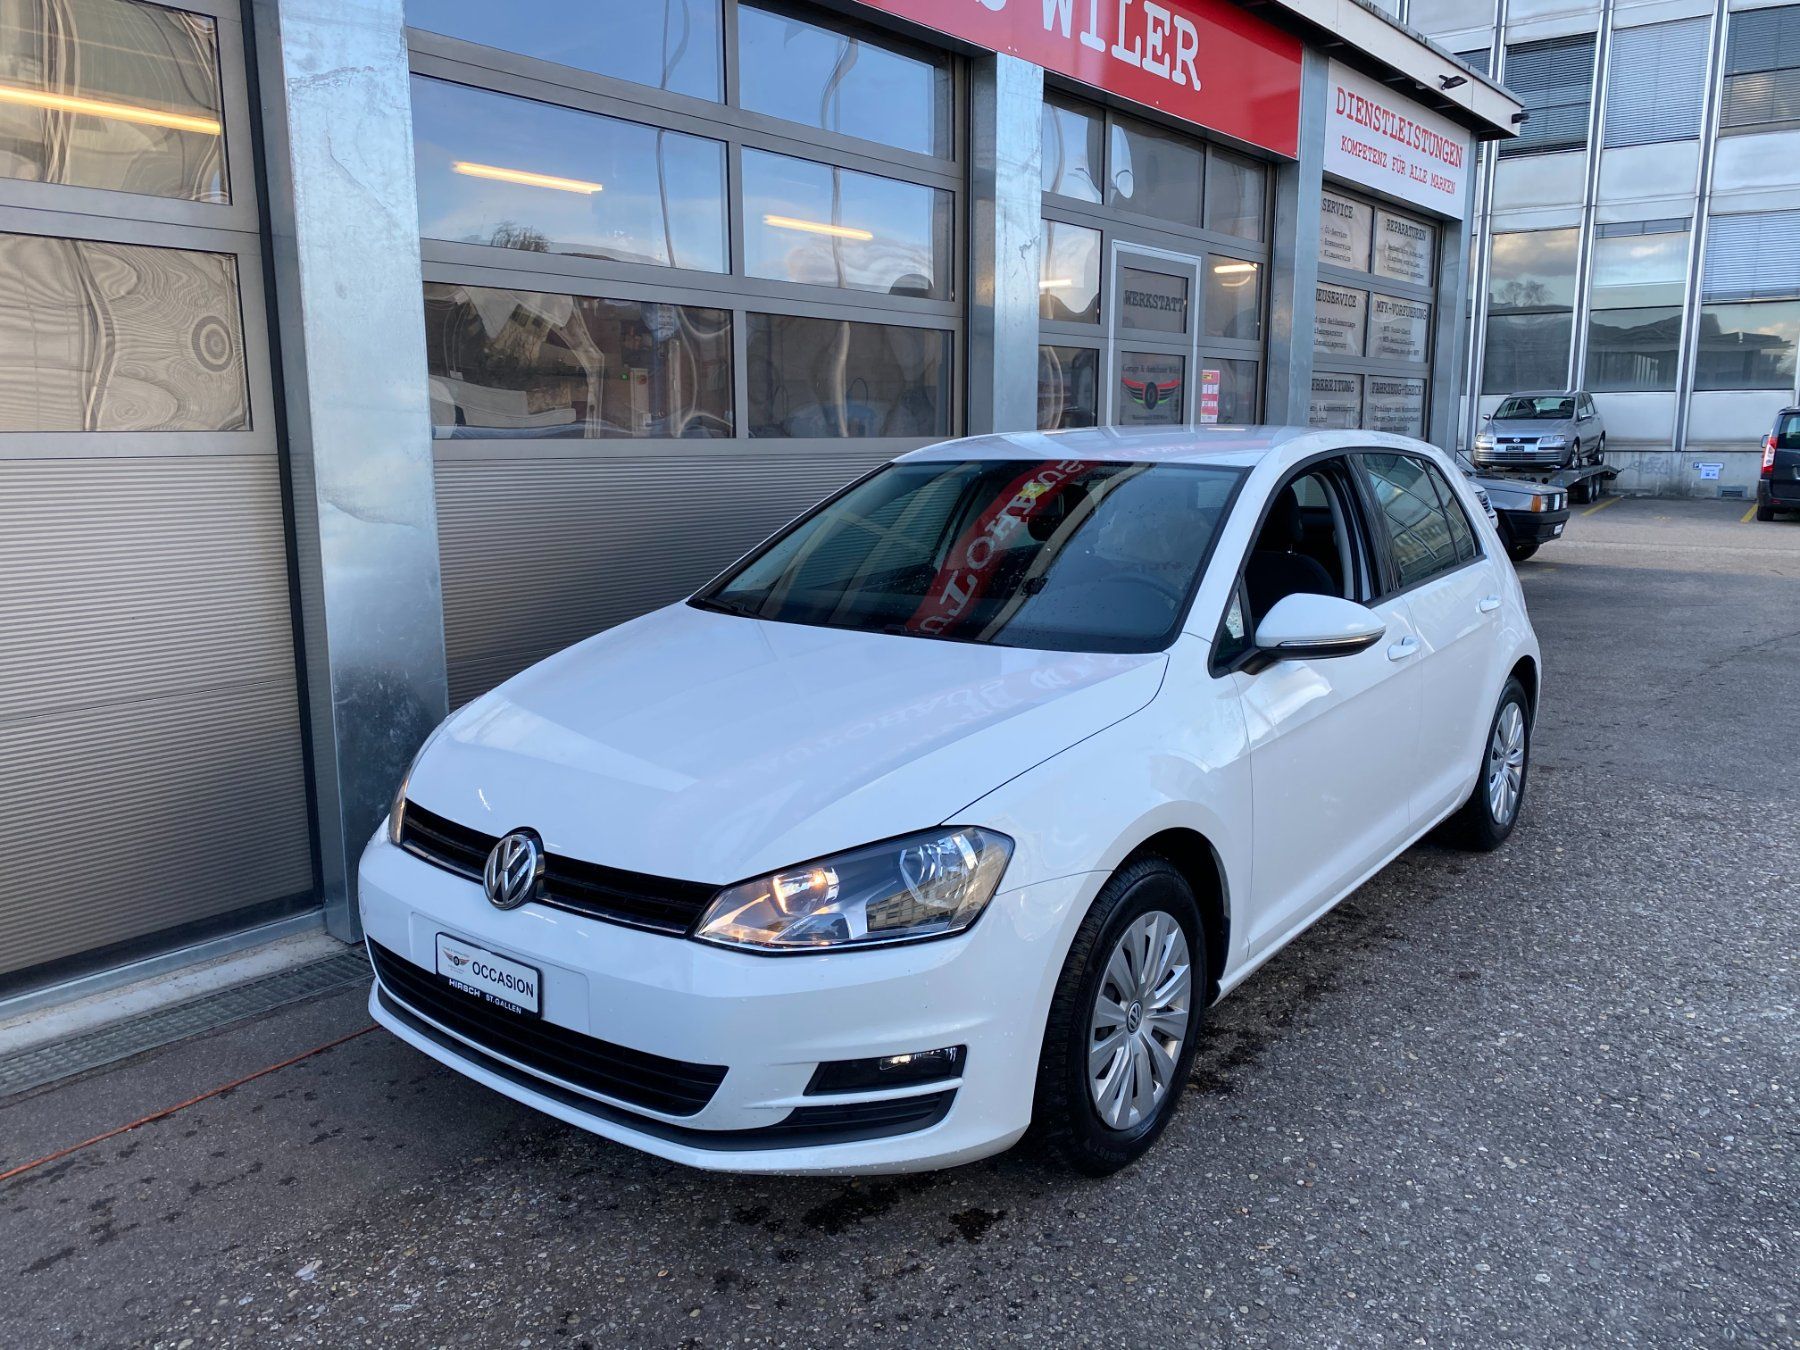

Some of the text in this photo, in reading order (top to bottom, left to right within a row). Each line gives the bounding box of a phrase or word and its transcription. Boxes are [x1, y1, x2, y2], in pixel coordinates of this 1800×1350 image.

[1336, 86, 1463, 169] DIENSTLEISTUNGEN
[1340, 135, 1456, 195] KOMPETENZ FÜR ALLE MARKEN
[1321, 198, 1354, 219] SERVICE
[1386, 218, 1427, 241] REPARATUREN
[1124, 290, 1184, 313] WERKSTATT
[449, 978, 481, 998] HIRSCH
[472, 961, 534, 998] OCCASION
